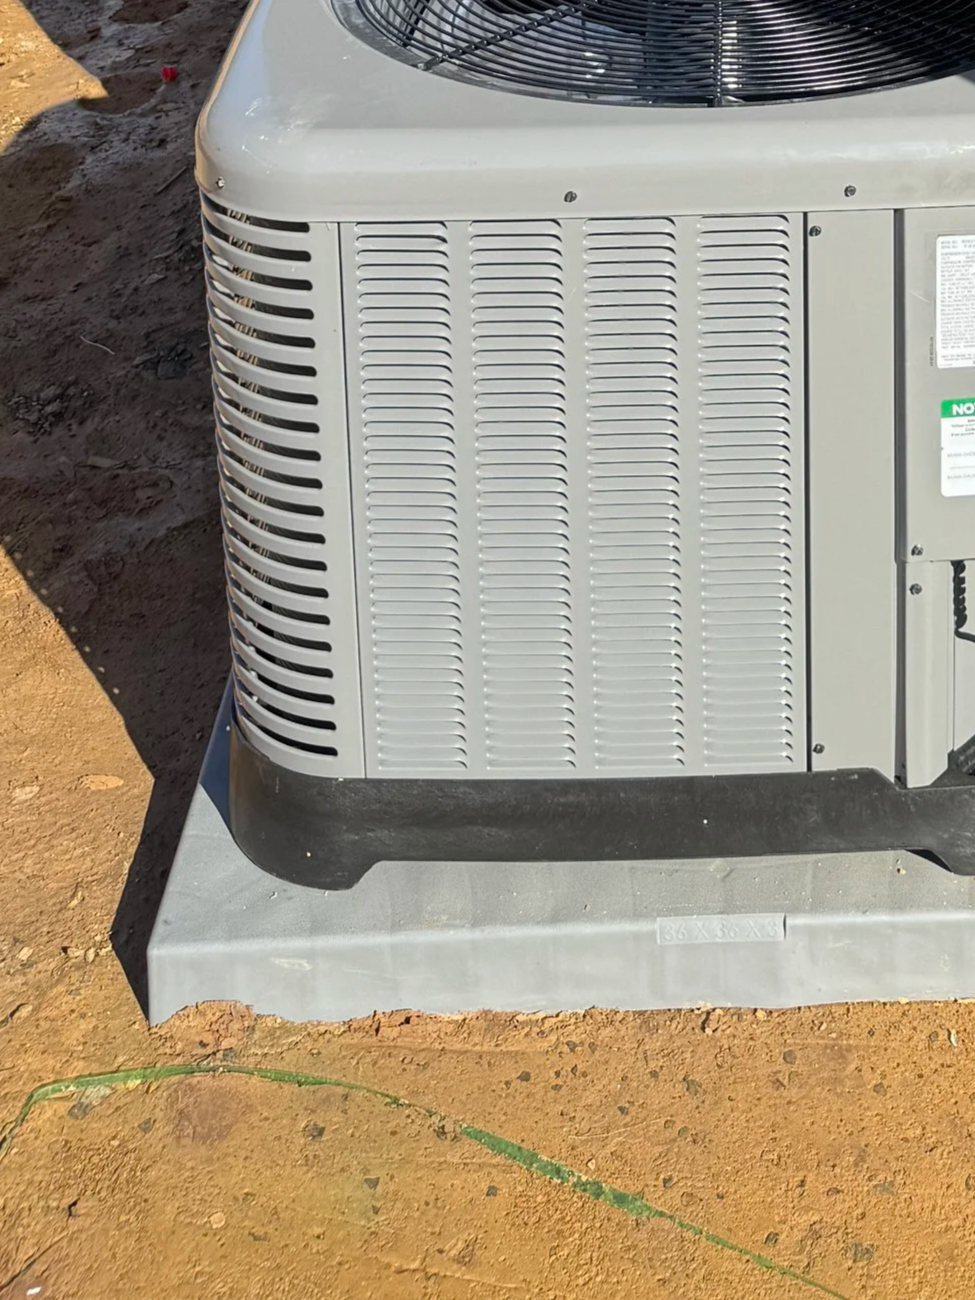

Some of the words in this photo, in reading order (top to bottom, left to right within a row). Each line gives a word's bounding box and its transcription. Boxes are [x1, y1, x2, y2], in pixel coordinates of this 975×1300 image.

[664, 922, 687, 941] 36
[694, 920, 710, 940] X
[747, 919, 762, 938] X
